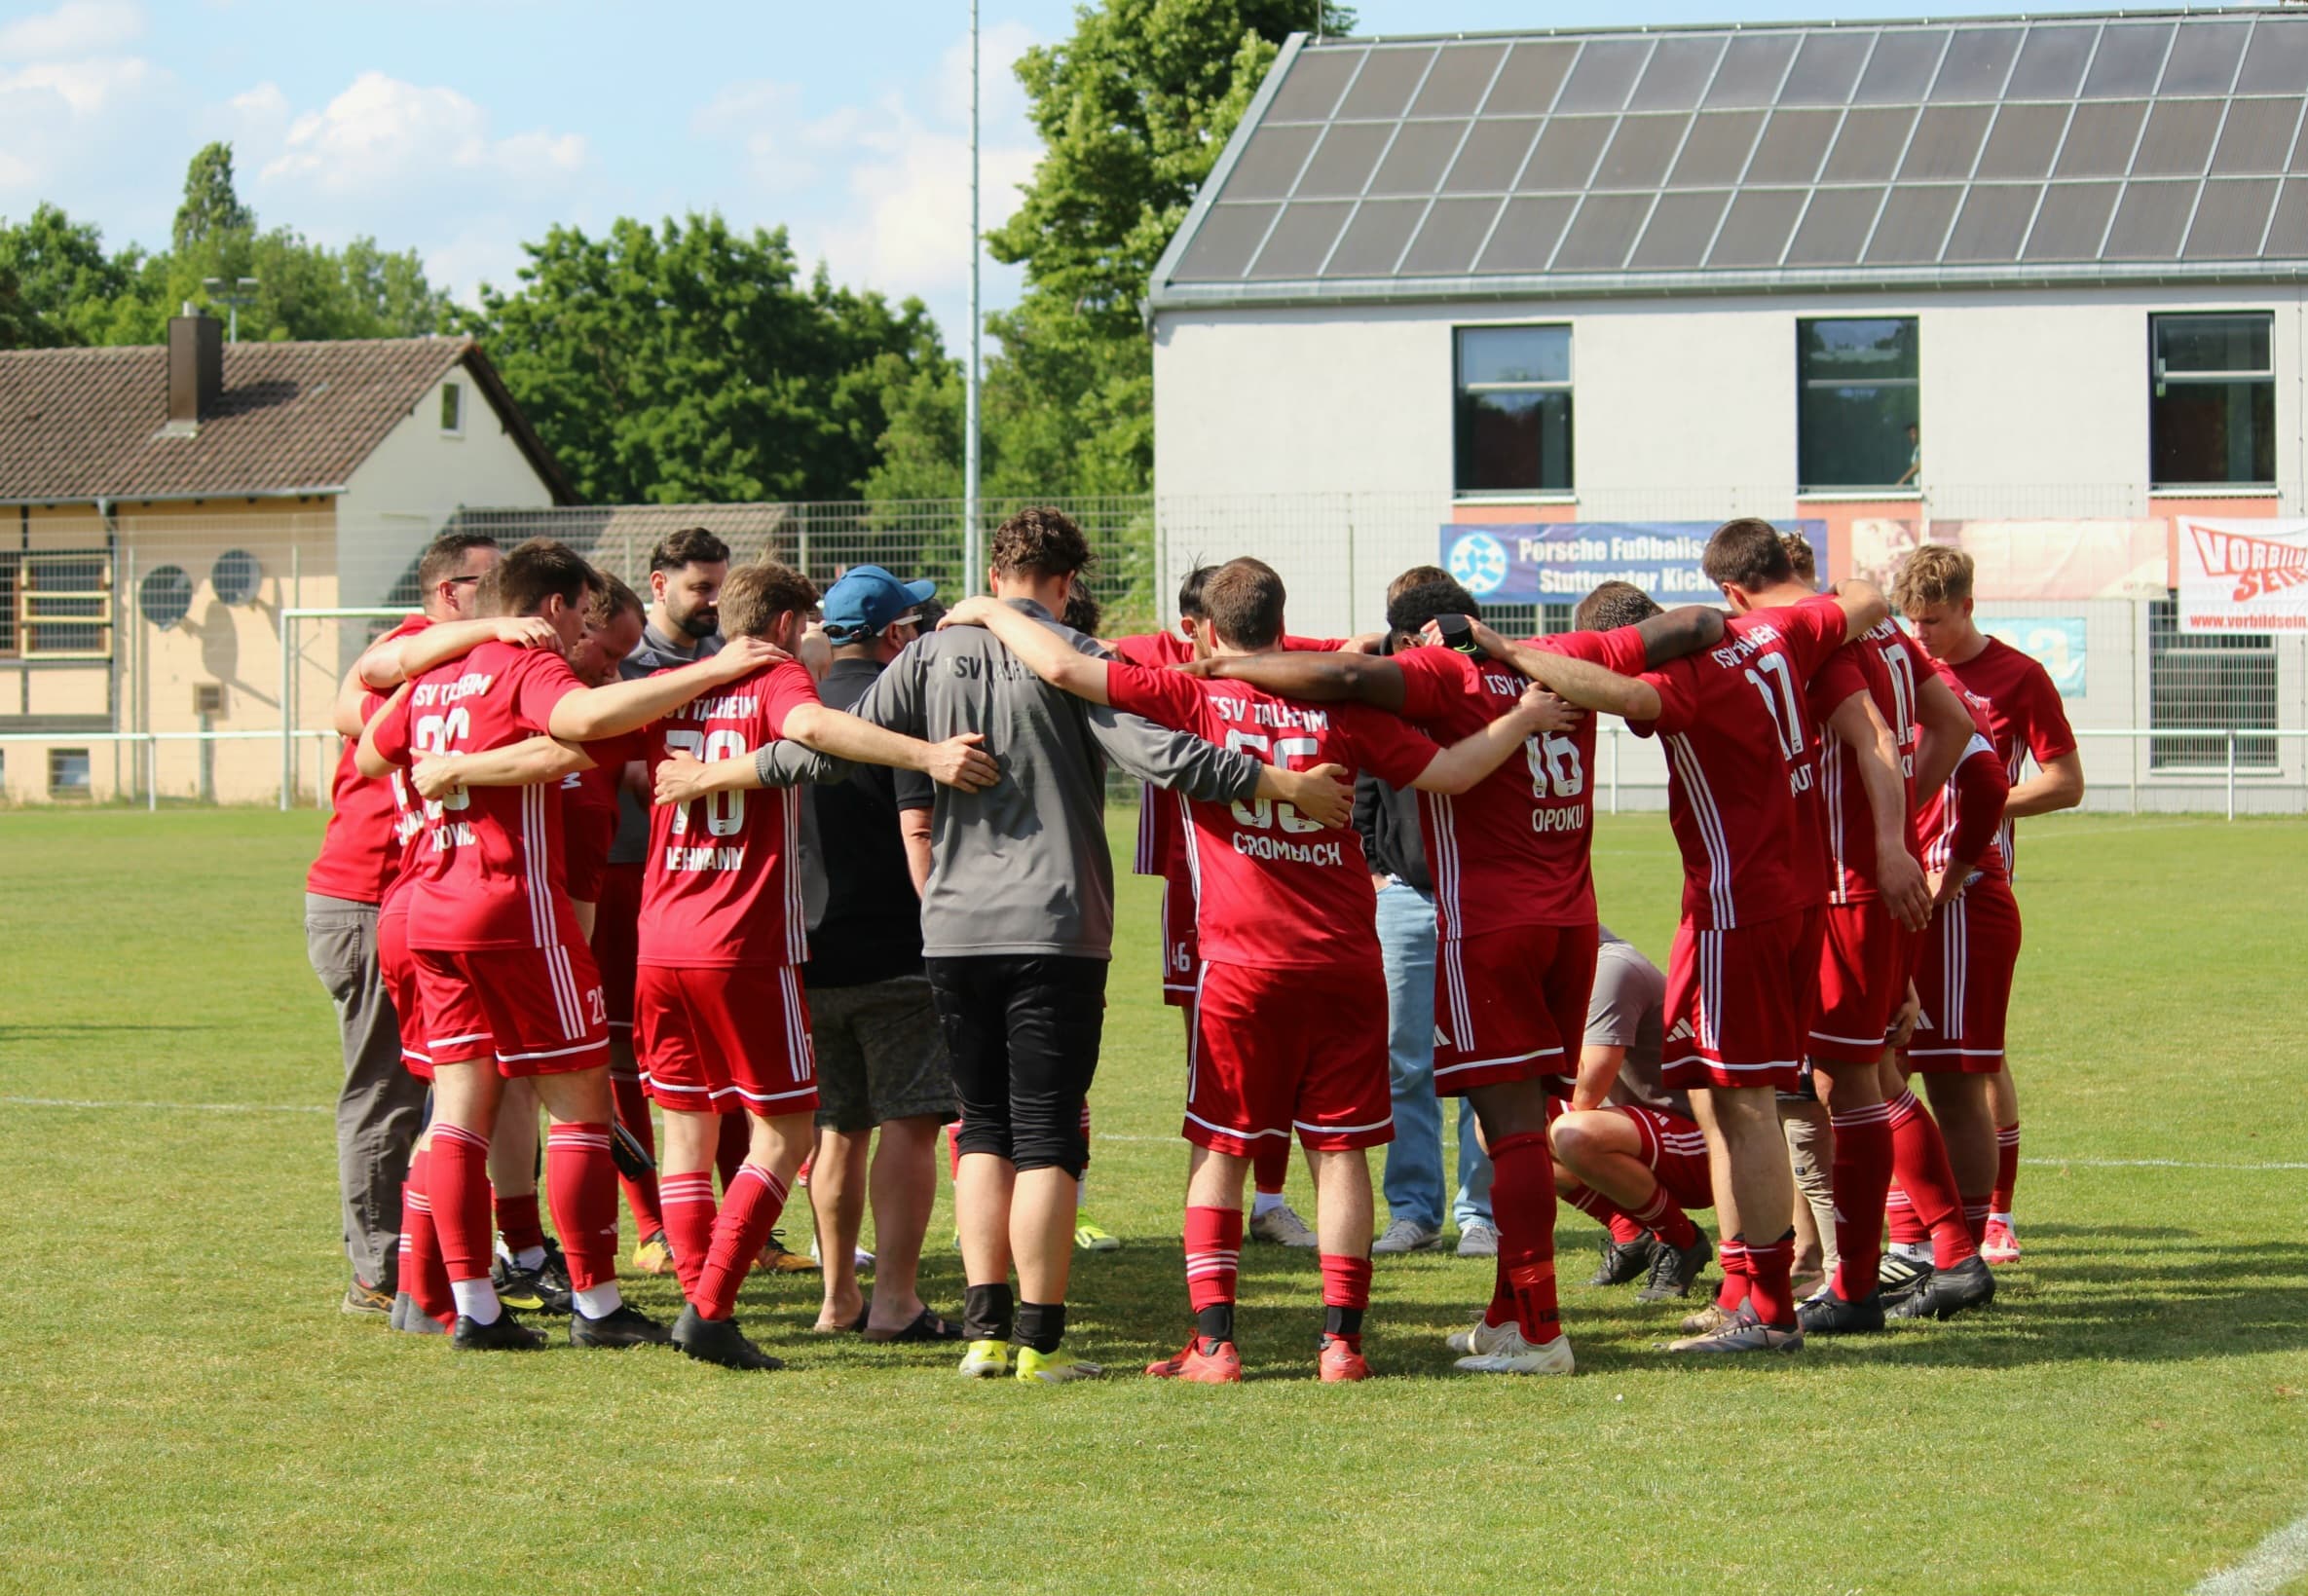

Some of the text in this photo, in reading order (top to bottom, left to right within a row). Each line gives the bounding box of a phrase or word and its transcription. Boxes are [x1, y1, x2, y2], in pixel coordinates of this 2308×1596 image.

[1519, 538, 1607, 562] Porsche
[2194, 529, 2307, 573] VORBILD
[1662, 567, 1720, 592] Kick
[1484, 674, 1517, 697] TSV
[1209, 695, 1247, 723] TSV
[1744, 651, 1805, 761] 17
[1525, 730, 1583, 799] 16
[666, 729, 746, 836] 70
[1532, 804, 1585, 834] OPOKU
